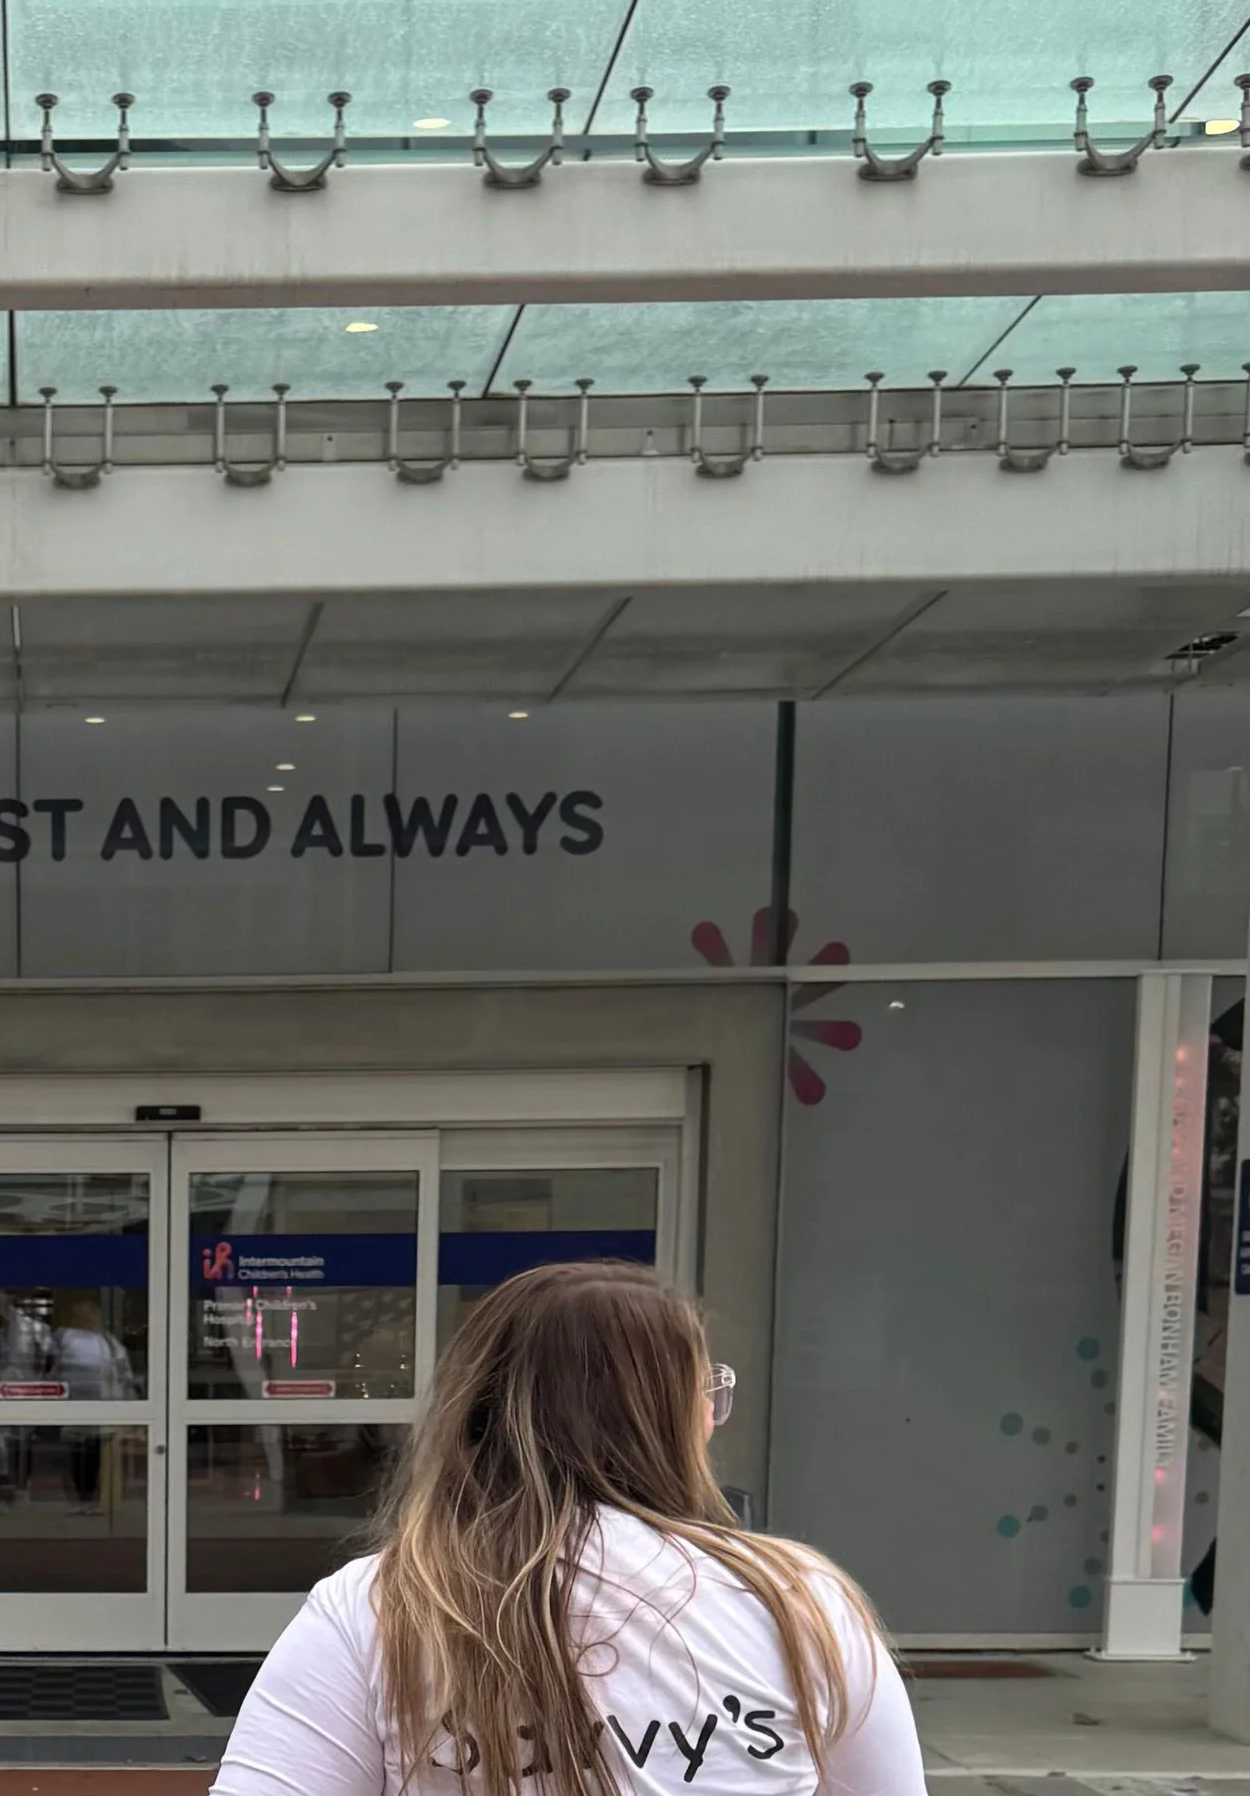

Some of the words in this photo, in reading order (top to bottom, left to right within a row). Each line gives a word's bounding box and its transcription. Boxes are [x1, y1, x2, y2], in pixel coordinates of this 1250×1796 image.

[100, 796, 272, 861] AND
[290, 790, 604, 859] ALWAYS
[1158, 1291, 1182, 1390] BONHAM
[1155, 1397, 1177, 1468] FAMILY
